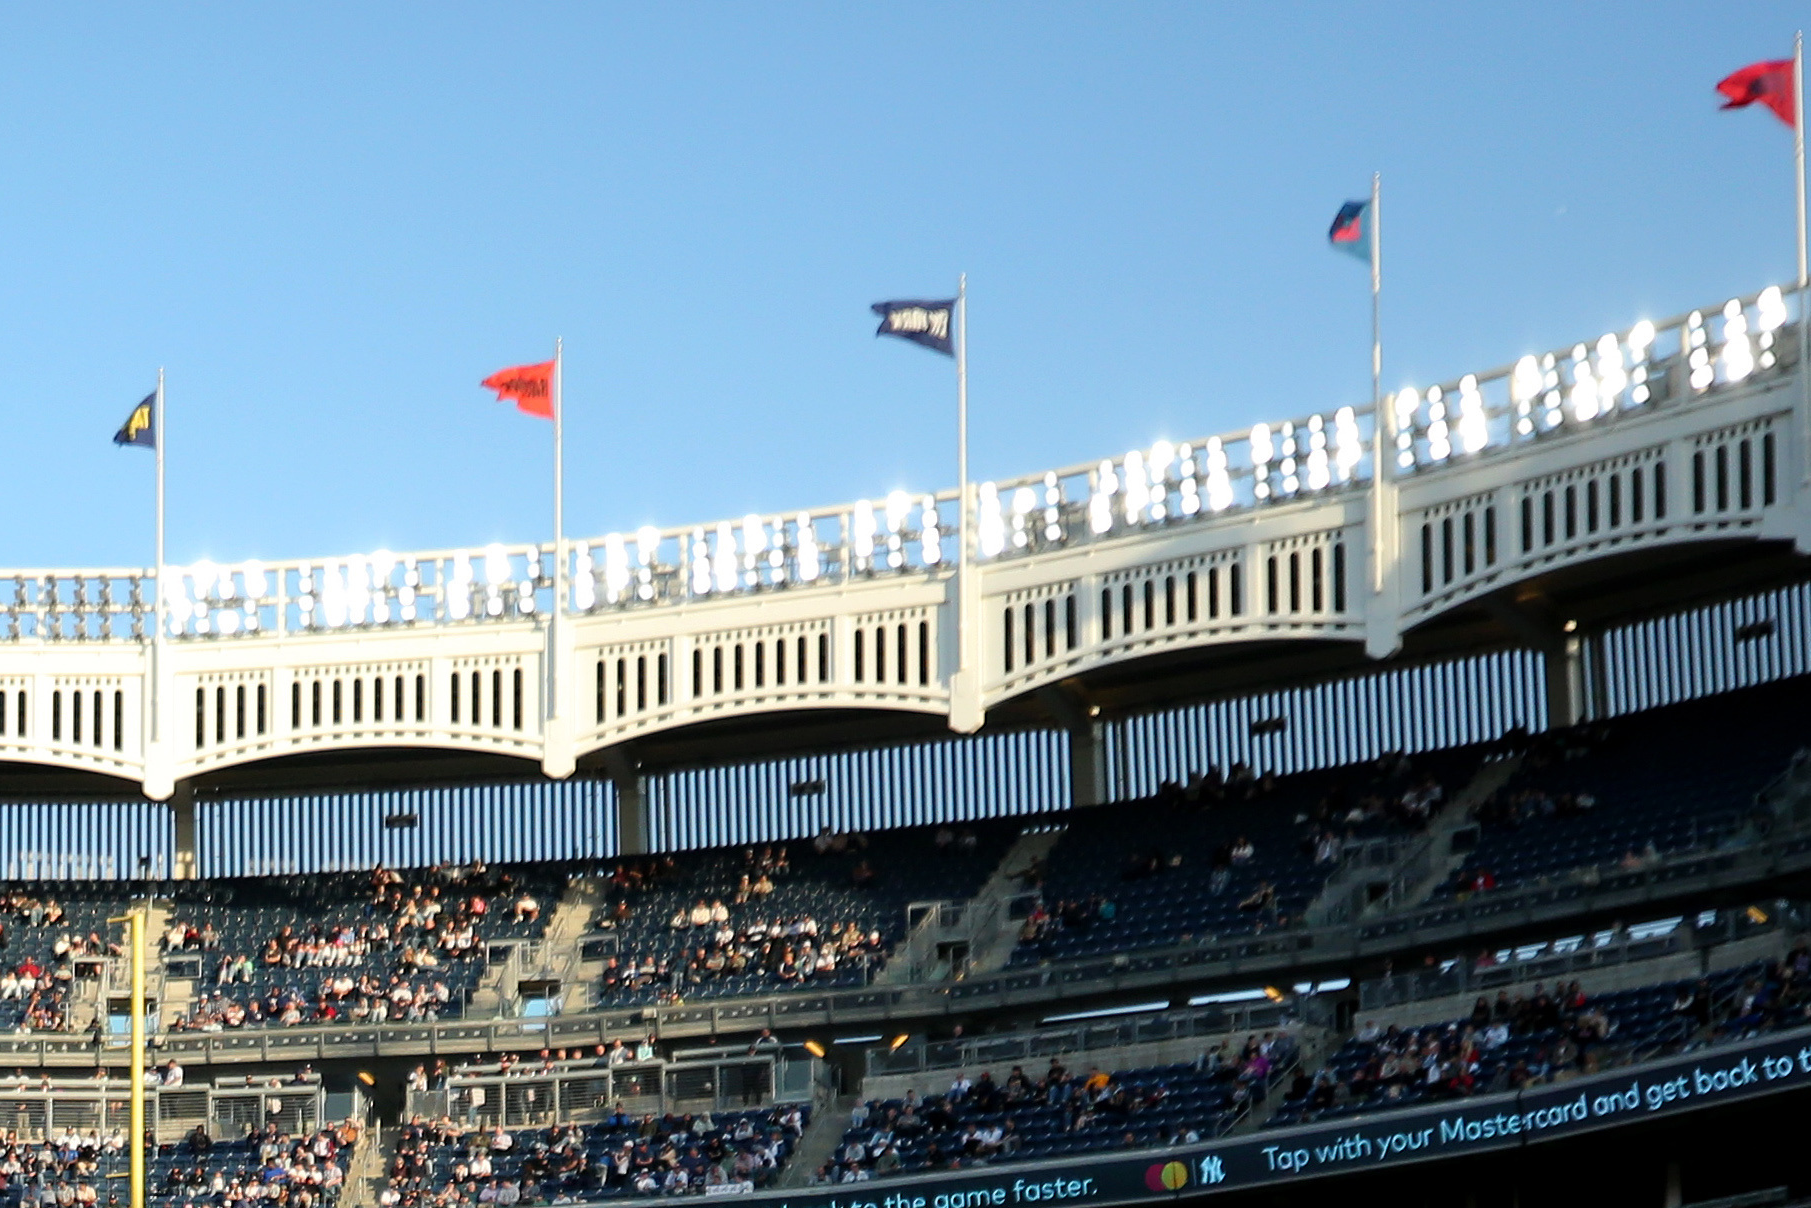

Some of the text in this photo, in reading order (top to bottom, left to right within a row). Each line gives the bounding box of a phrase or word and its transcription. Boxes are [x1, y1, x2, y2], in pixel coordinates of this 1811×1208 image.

[1262, 1145, 1310, 1174] Tap
[1316, 1132, 1372, 1164] with
[1376, 1127, 1433, 1161] your
[1440, 1092, 1588, 1146] Mastercard
[1593, 1081, 1641, 1117] and
[1647, 1075, 1690, 1110] get
[1693, 1056, 1759, 1094] back
[1761, 1055, 1794, 1081] to
[1012, 1176, 1097, 1202] faster.
